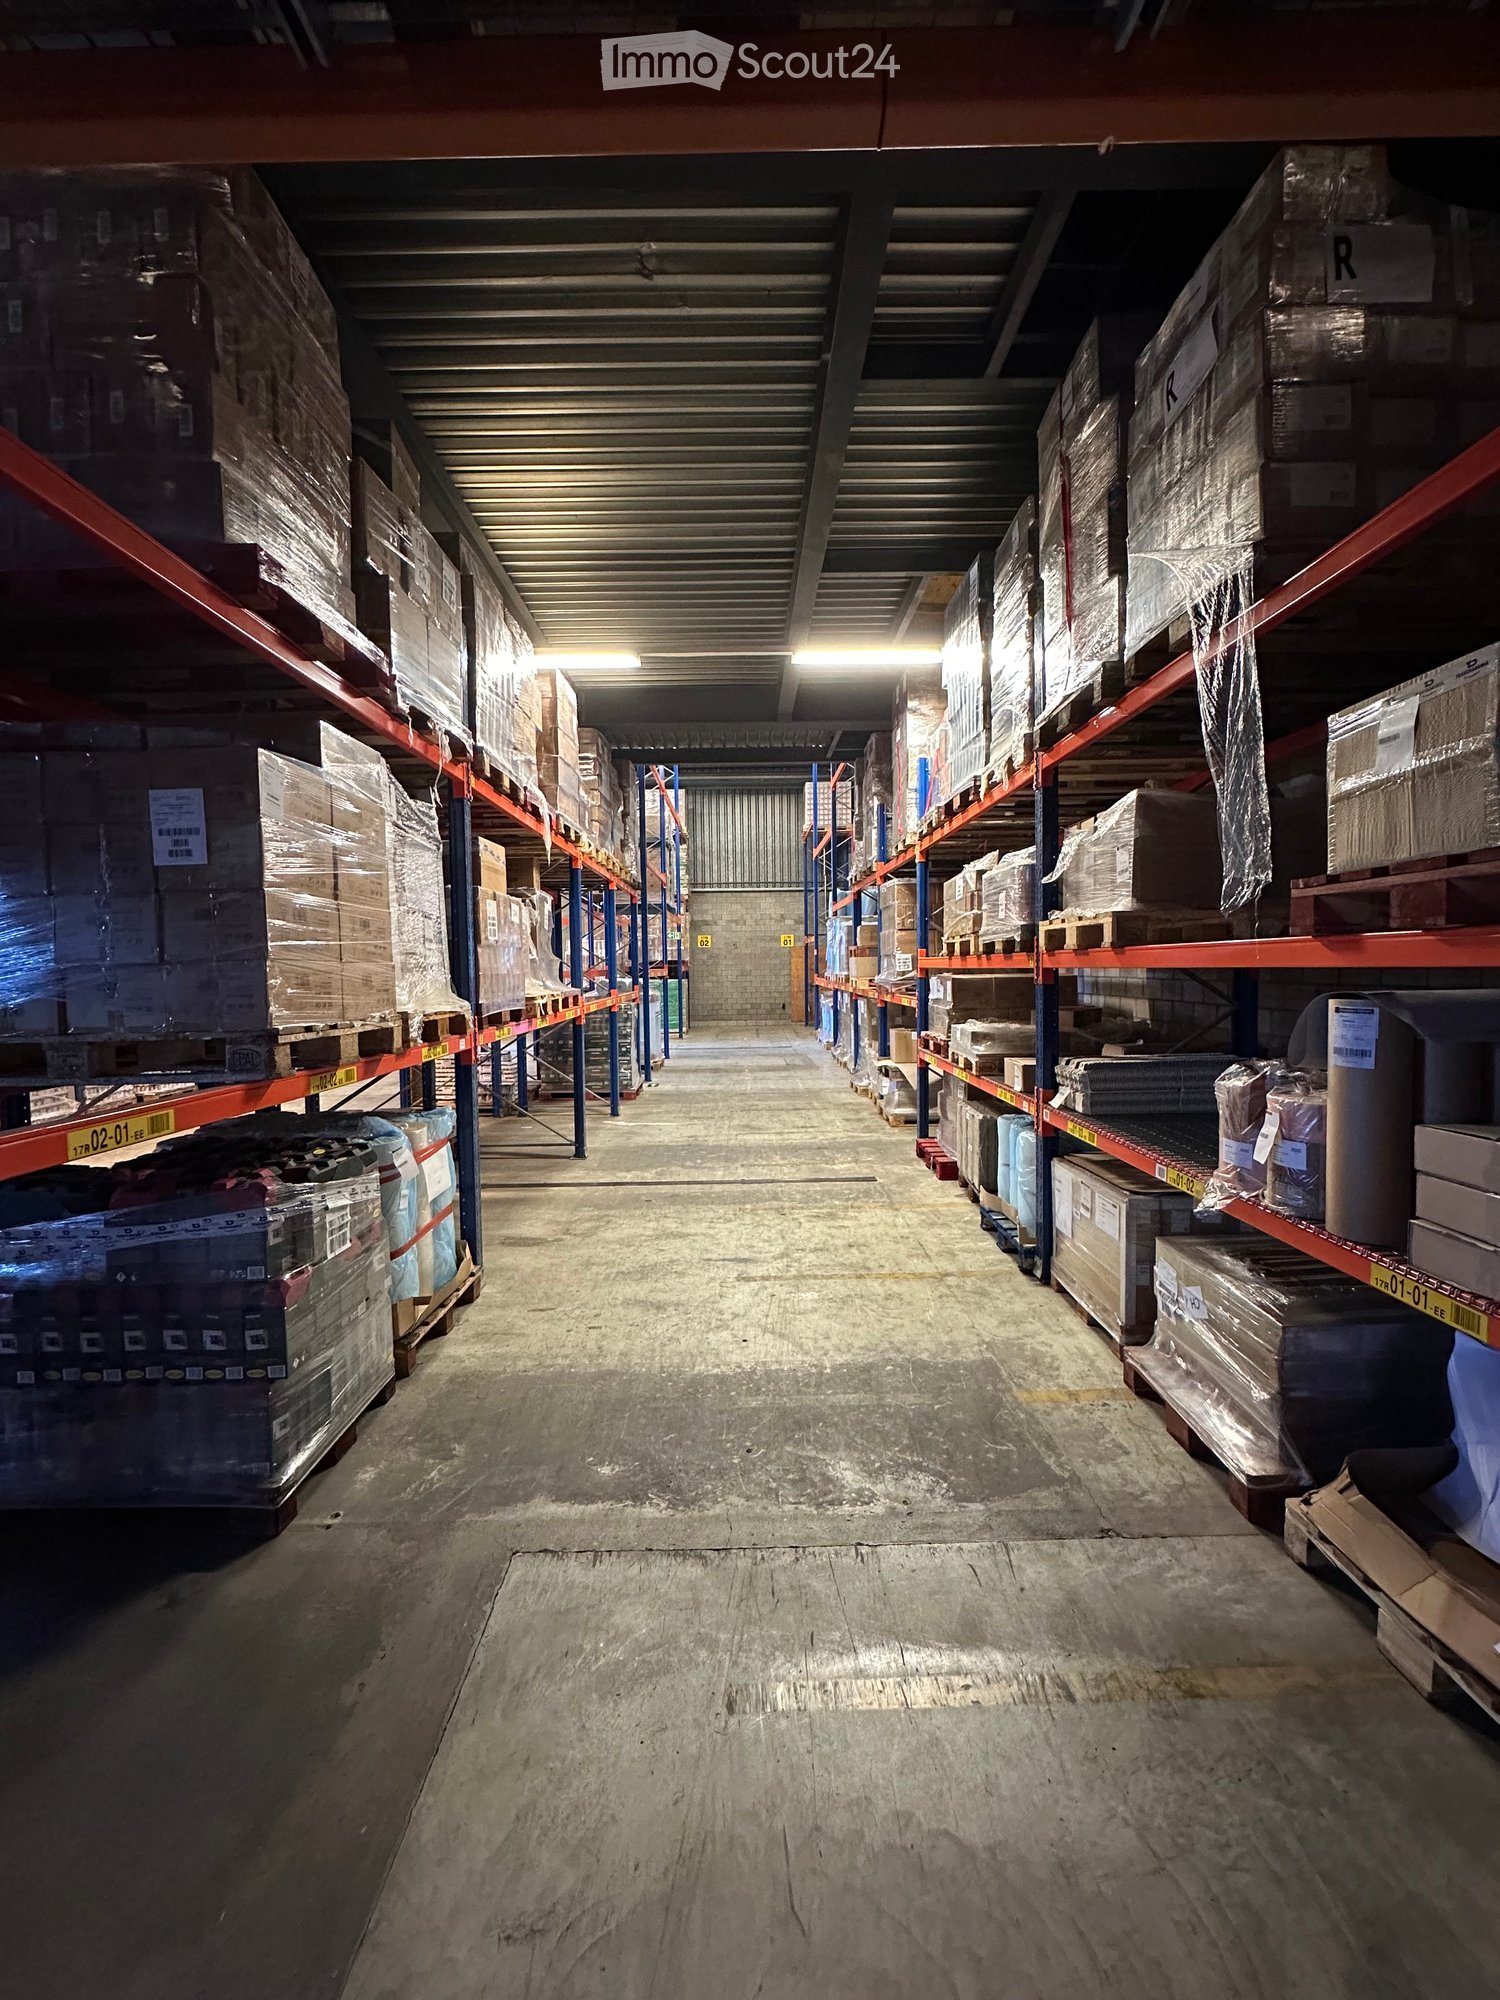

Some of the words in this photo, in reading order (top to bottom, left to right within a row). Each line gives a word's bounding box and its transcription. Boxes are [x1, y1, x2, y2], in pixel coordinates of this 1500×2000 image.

[1333, 235, 1357, 281] R
[1166, 370, 1178, 412] R
[699, 939, 709, 947] 02
